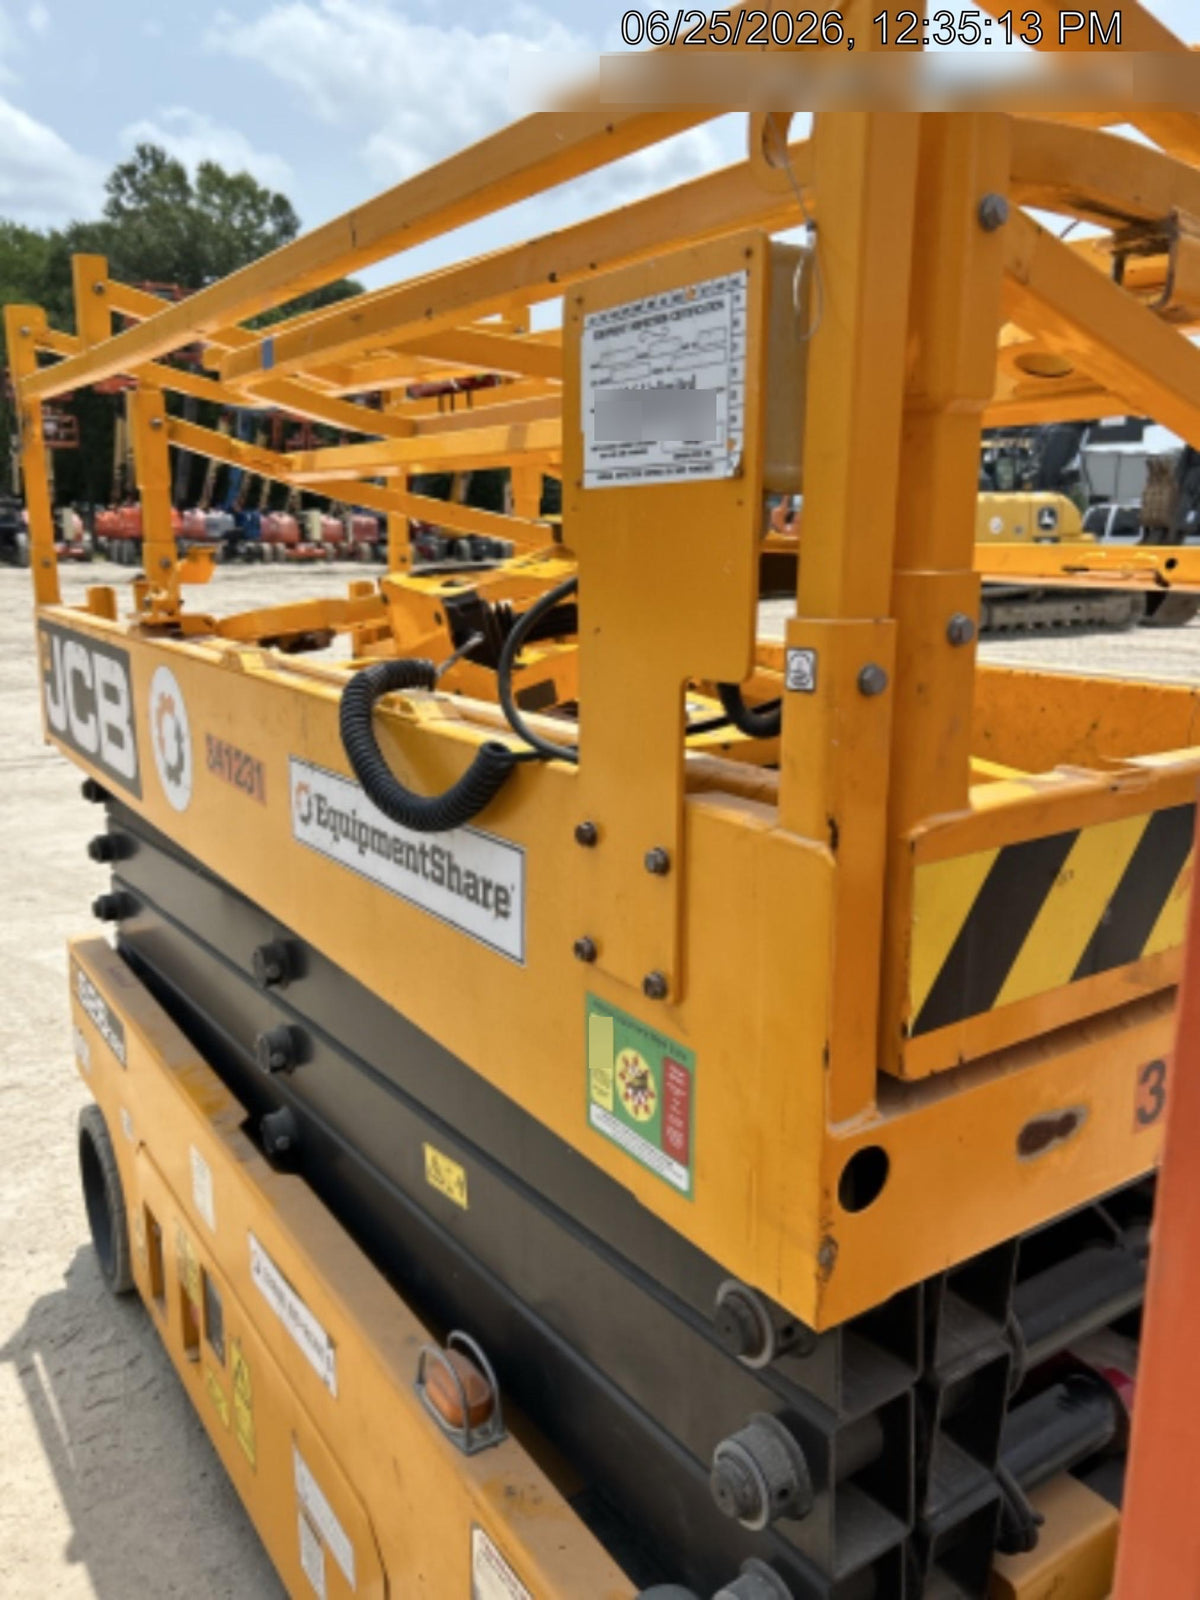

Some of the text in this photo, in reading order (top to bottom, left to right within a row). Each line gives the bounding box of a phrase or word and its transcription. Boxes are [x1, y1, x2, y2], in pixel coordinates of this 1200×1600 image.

[45, 634, 137, 780] JCB
[314, 792, 513, 920] EquipmentShare
[1136, 1058, 1167, 1126] 3
